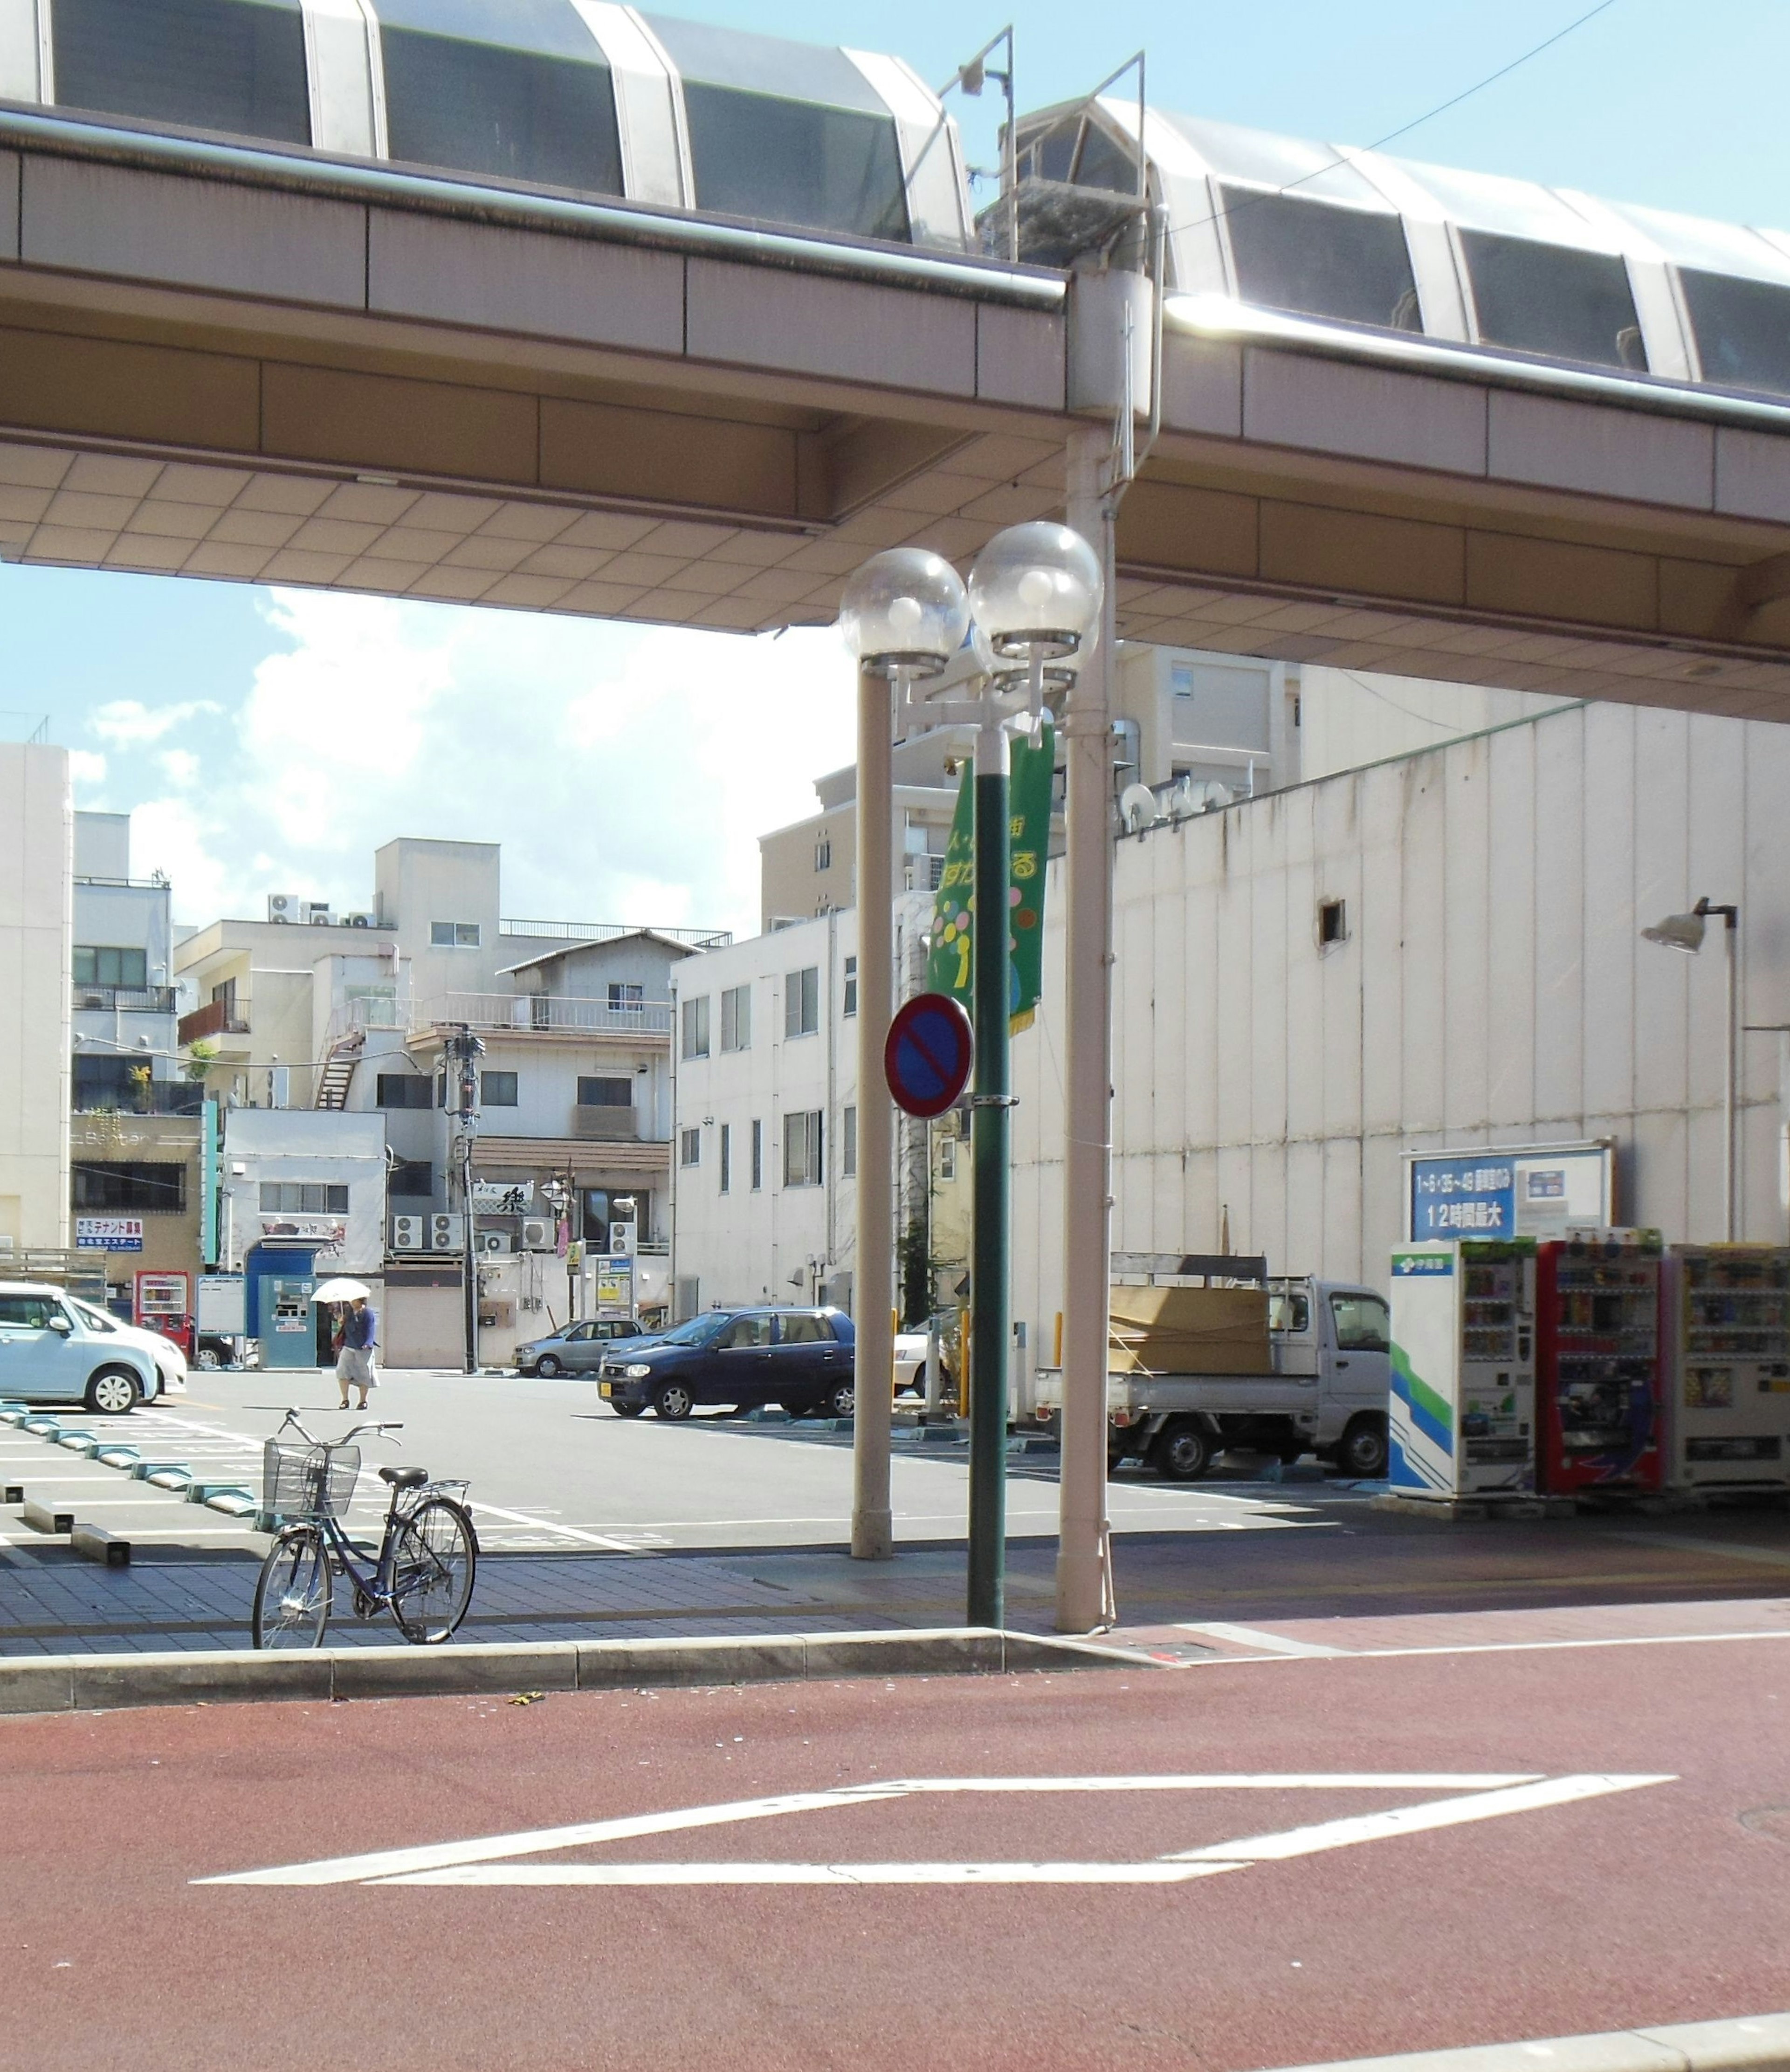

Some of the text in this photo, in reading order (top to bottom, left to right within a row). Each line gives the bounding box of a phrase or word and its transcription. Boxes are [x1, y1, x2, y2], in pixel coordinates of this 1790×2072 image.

[95, 1221, 141, 1235] テナント募集
